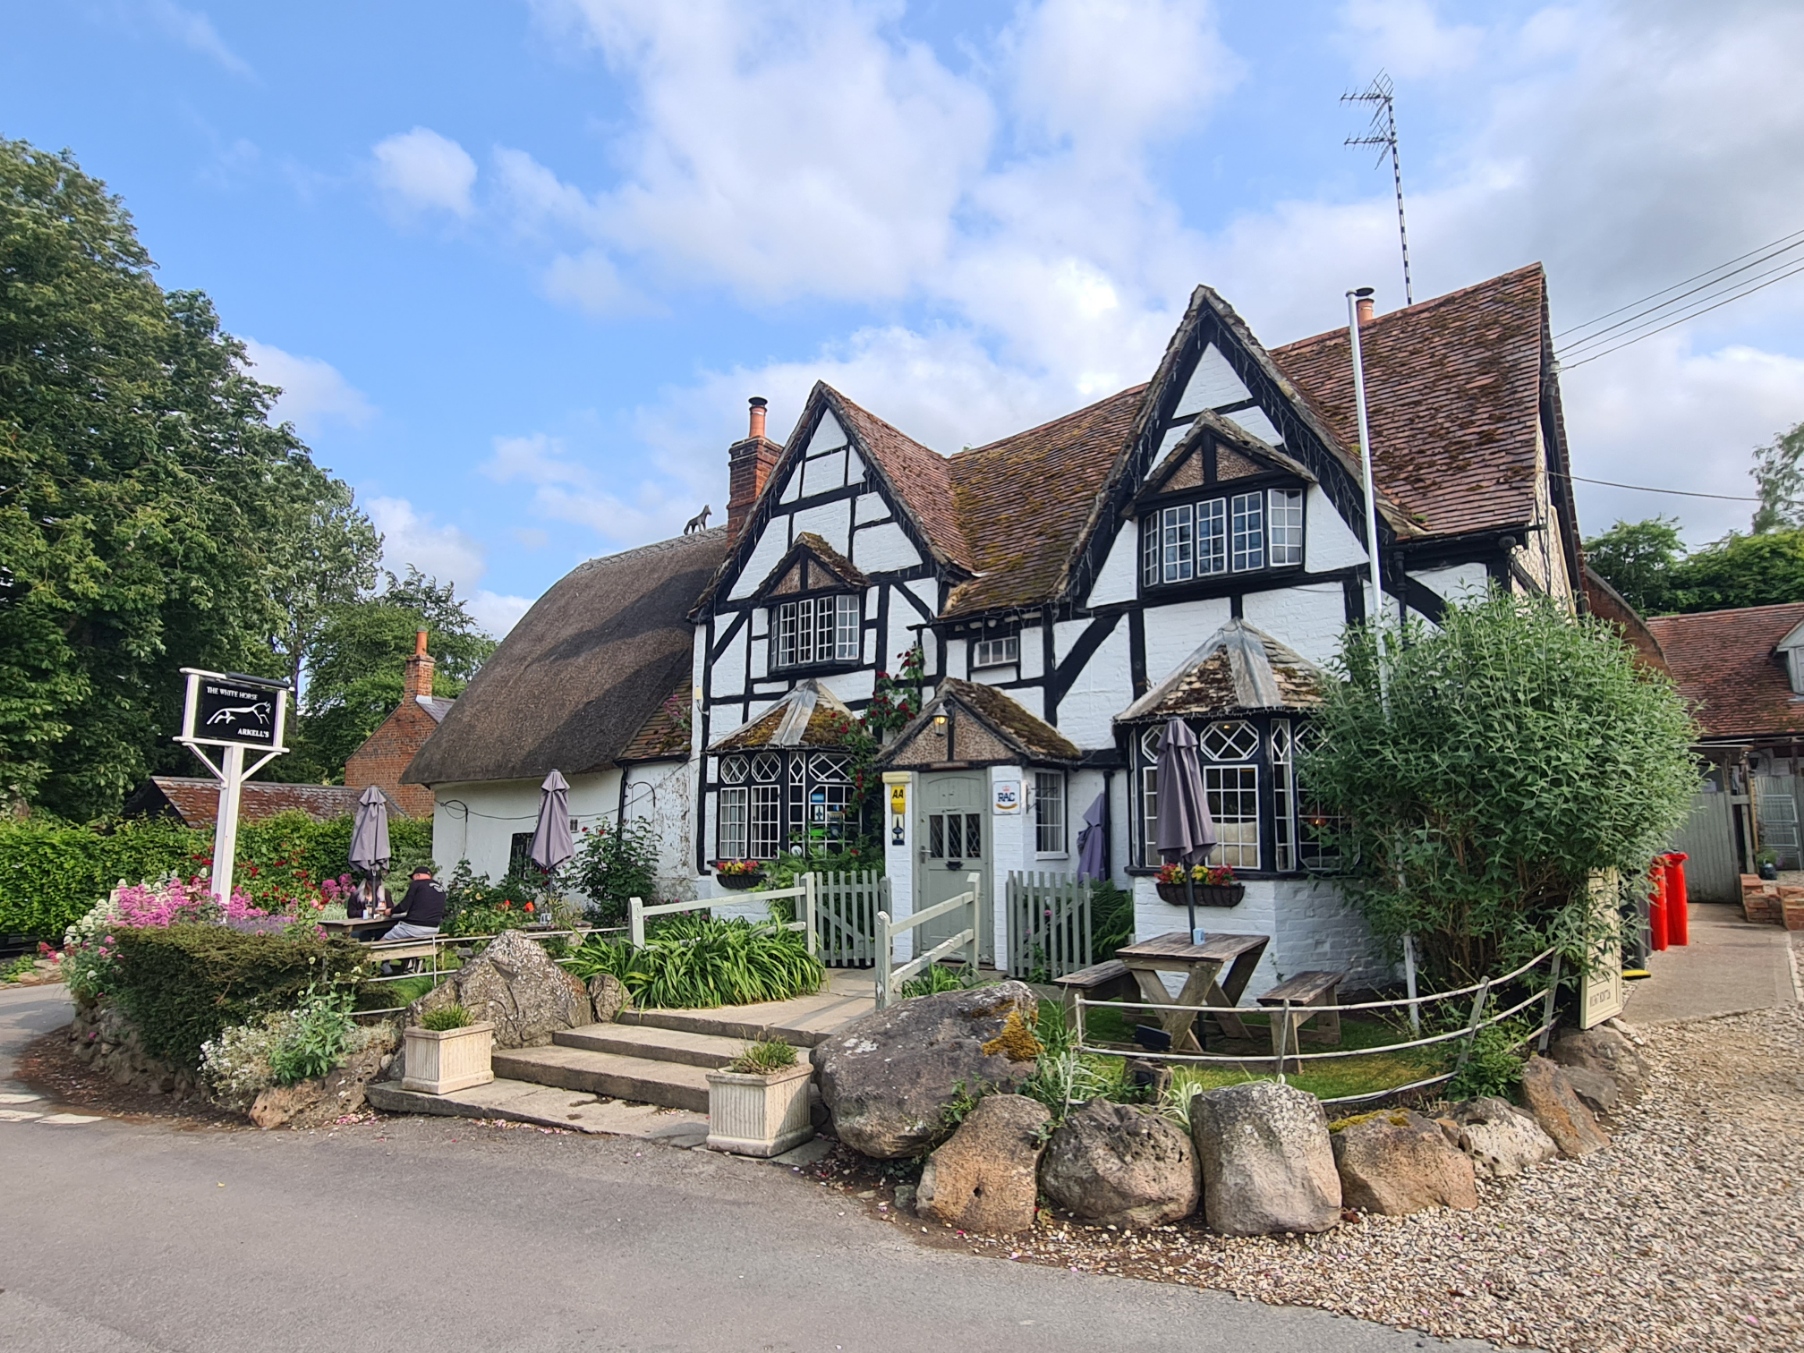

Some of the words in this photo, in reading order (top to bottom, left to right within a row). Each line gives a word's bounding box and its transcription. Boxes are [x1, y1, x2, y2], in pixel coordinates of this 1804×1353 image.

[207, 686, 219, 694] THE
[220, 689, 238, 697] WHITE
[239, 692, 258, 700] HORSE
[238, 728, 270, 738] ARKELL'S
[892, 789, 904, 799] AA
[997, 792, 1015, 802] RAC
